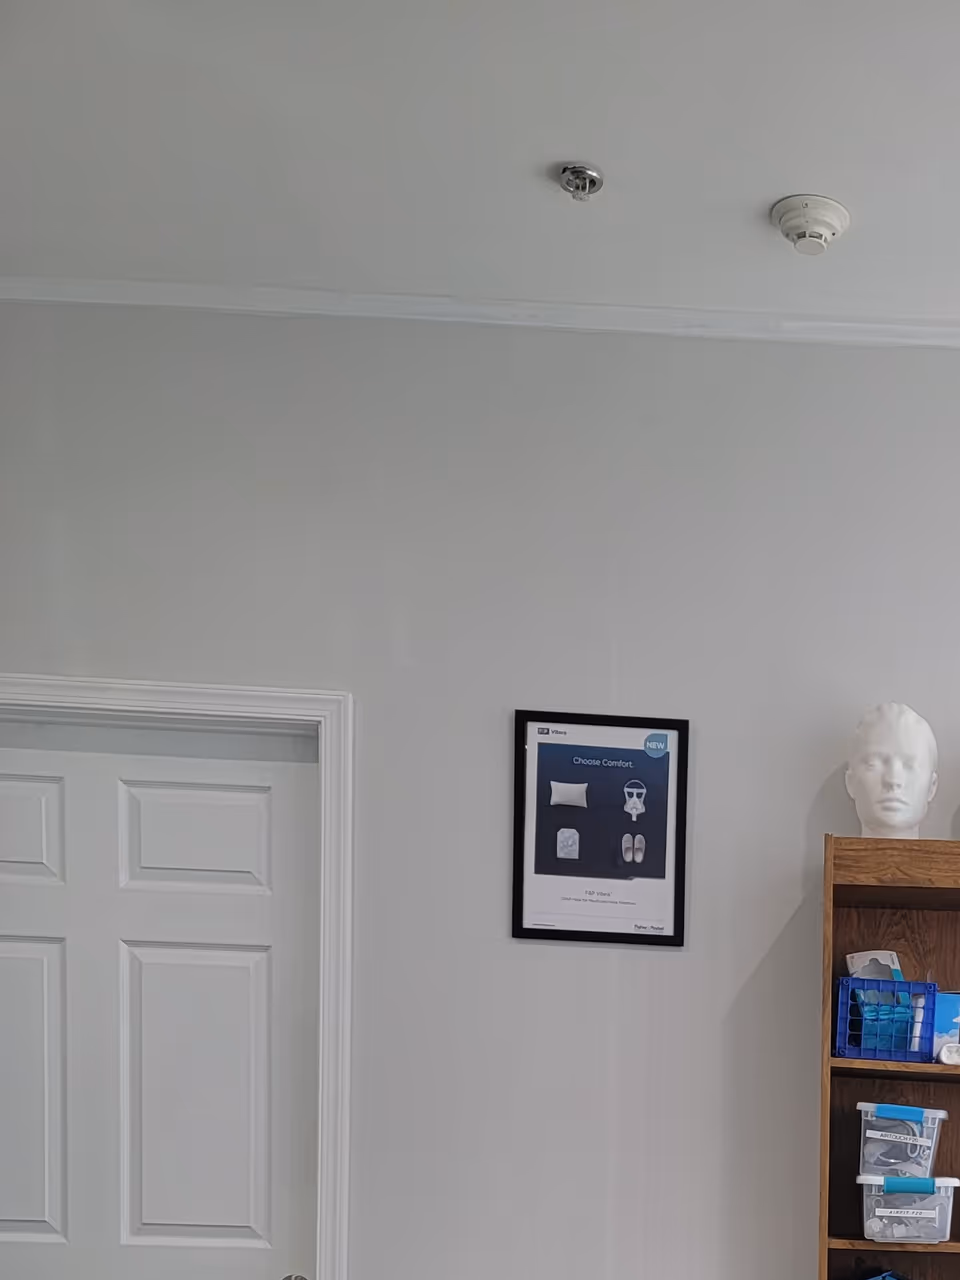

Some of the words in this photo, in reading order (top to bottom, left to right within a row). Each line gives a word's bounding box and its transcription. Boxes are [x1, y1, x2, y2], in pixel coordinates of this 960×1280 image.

[646, 741, 665, 749] NEW
[573, 756, 601, 766] Choose
[880, 1133, 908, 1141] AIRTOUCH
